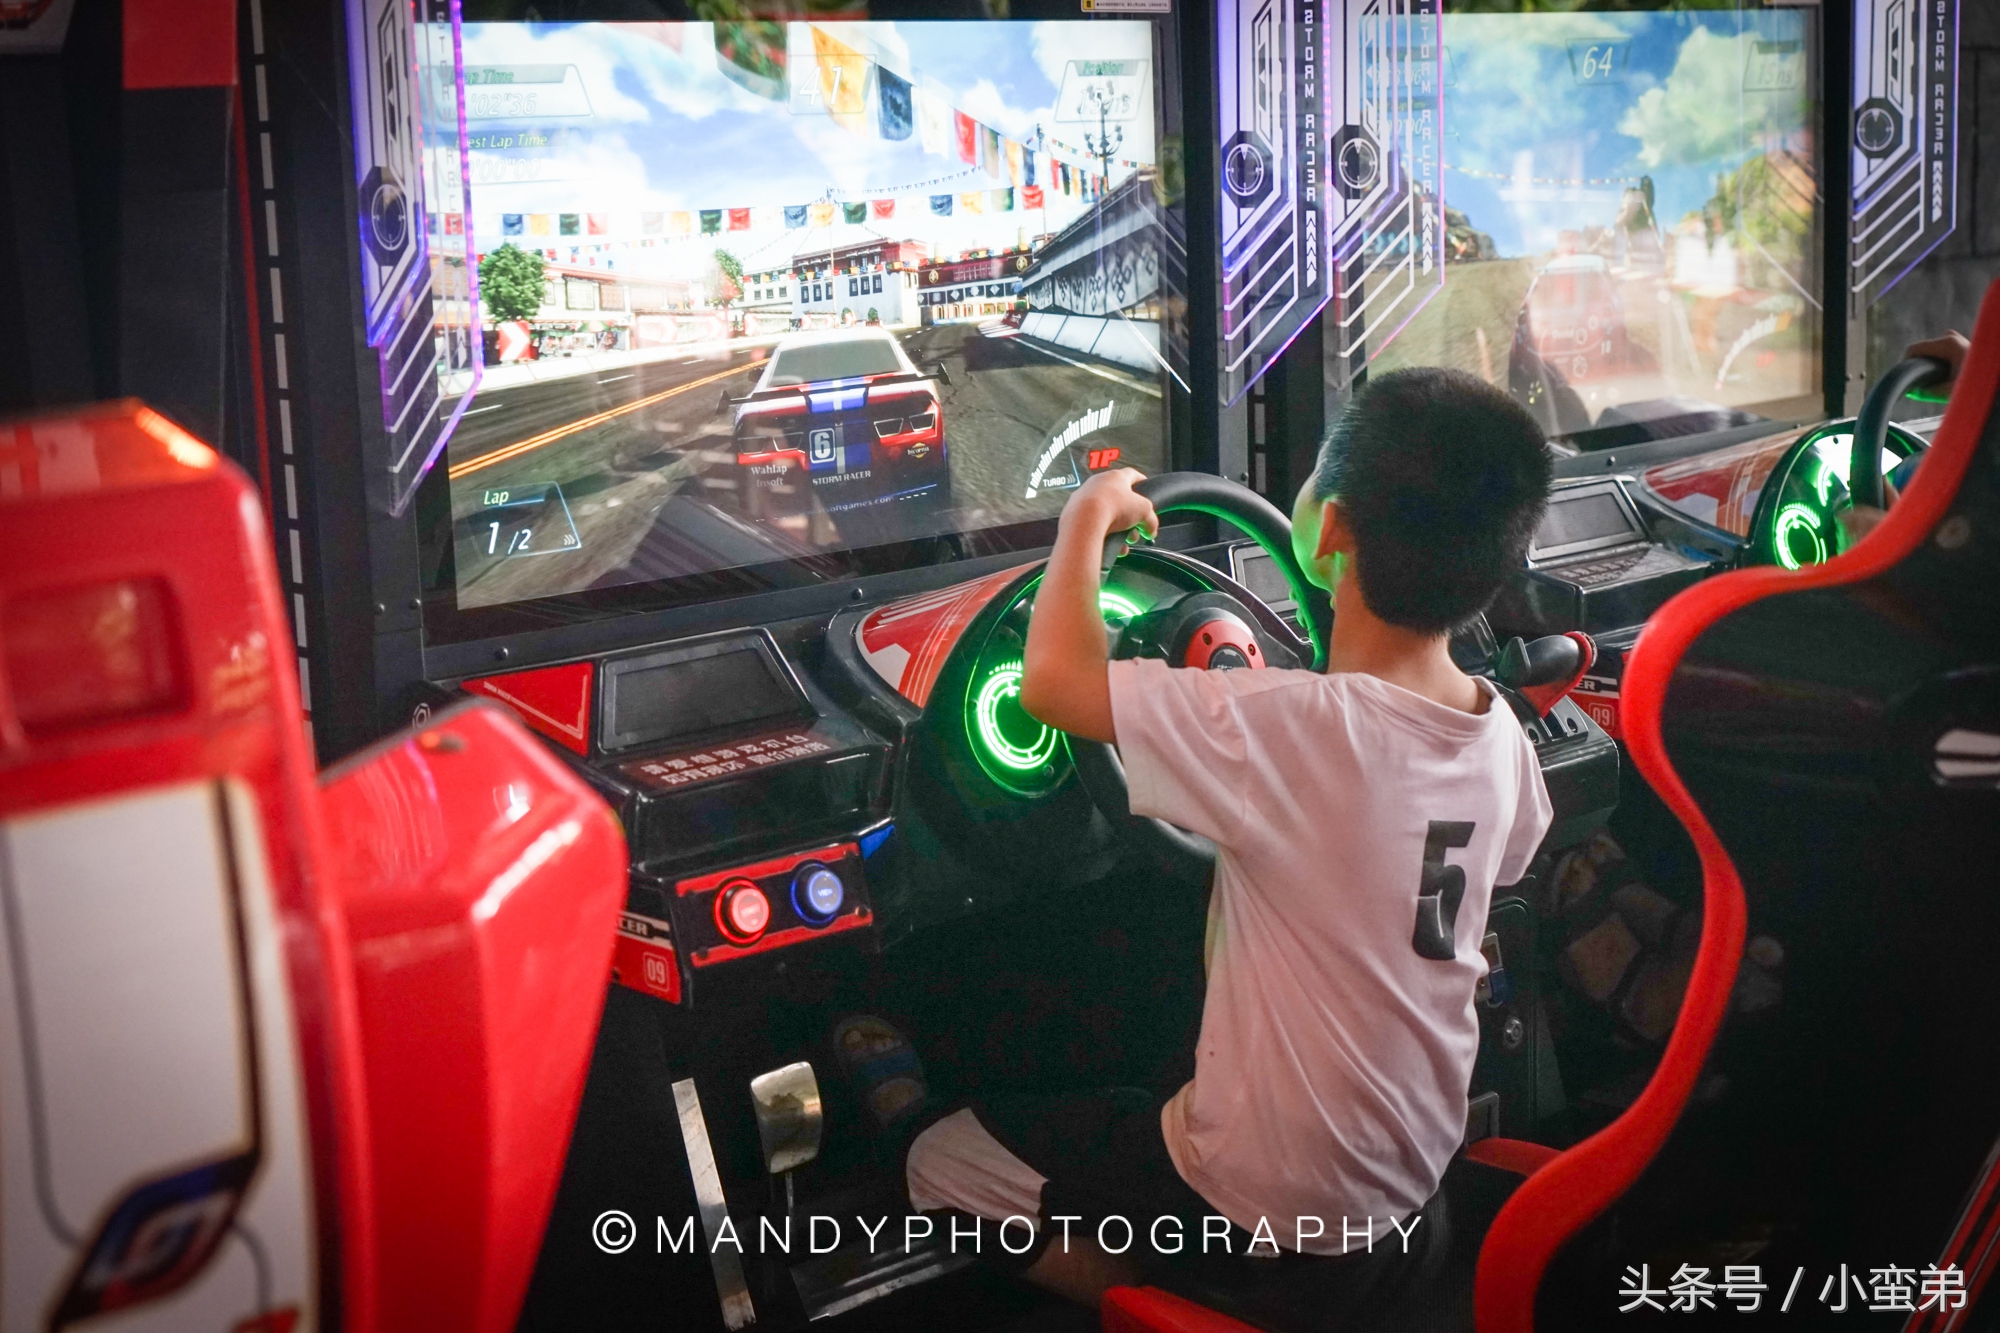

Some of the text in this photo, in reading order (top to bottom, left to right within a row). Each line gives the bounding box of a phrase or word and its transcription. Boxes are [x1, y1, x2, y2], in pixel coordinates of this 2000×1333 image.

[1083, 60, 1124, 76] Position
[1583, 46, 1613, 79] 64
[483, 69, 514, 84] Time
[799, 66, 842, 106] 41
[490, 135, 513, 150] Lap
[518, 134, 547, 147] Time
[814, 432, 831, 460] 6
[1089, 447, 1120, 470] 1P
[751, 464, 788, 476] Wahlap
[812, 469, 872, 486] STORM RACER
[1042, 476, 1067, 488] TURBO
[483, 490, 509, 506] Lap
[1592, 707, 1611, 727] 09
[817, 888, 833, 897] VIEW
[1412, 820, 1476, 961] 5
[647, 958, 666, 985] 09
